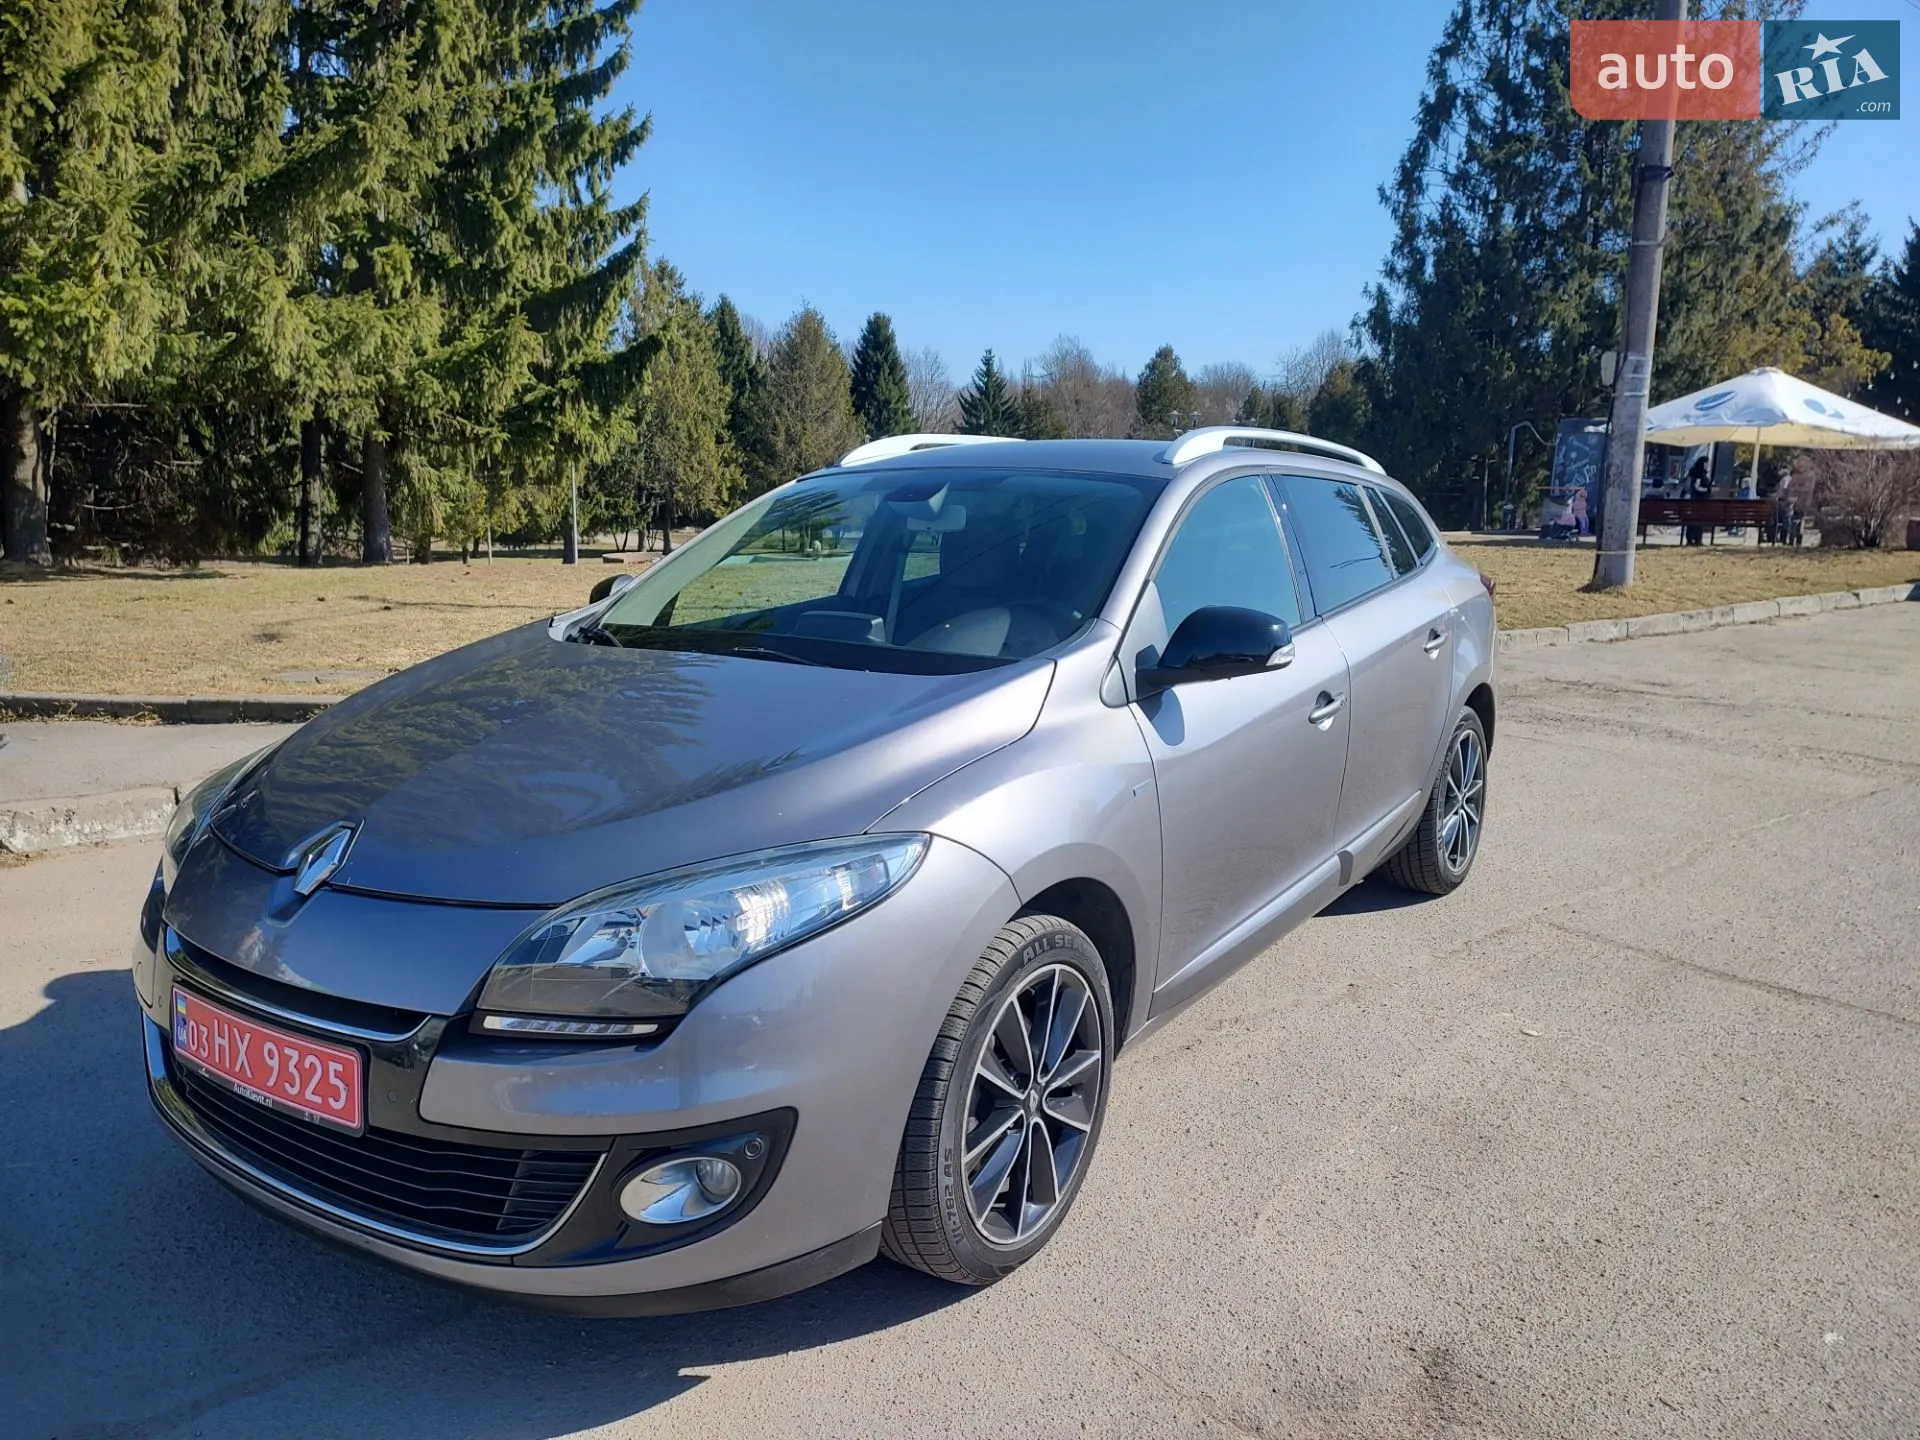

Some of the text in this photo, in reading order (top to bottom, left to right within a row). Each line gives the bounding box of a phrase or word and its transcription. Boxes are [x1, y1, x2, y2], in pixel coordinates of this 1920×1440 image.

[1023, 938, 1050, 965] ALL
[177, 1025, 187, 1044] UA
[263, 1041, 348, 1110] 9325
[943, 1147, 953, 1178] AS
